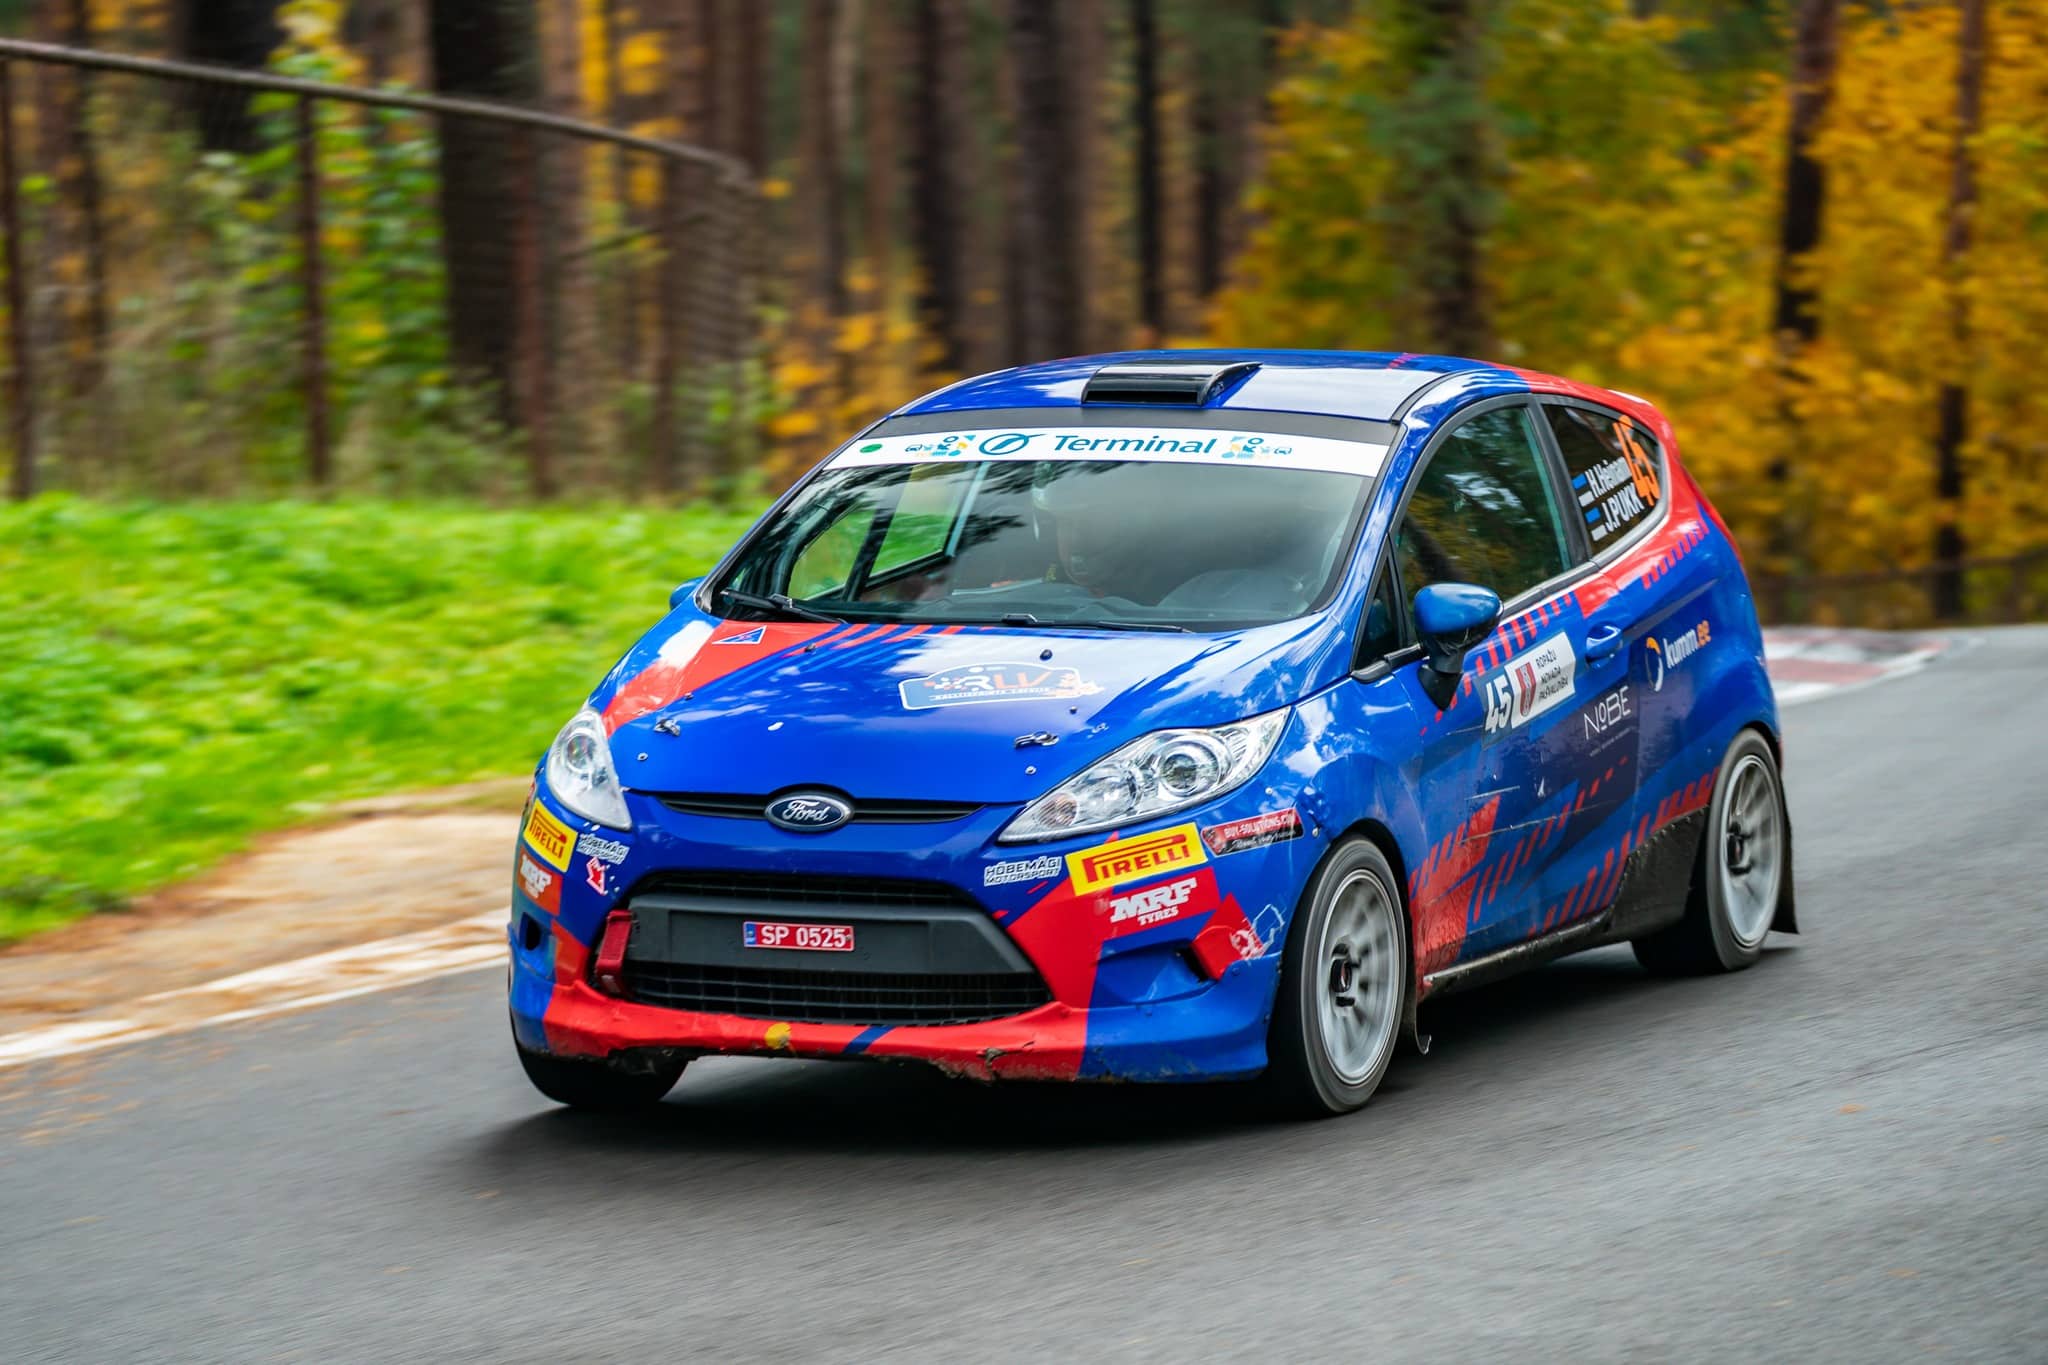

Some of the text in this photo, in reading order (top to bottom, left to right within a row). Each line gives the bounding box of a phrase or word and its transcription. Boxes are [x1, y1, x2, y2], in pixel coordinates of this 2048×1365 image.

[1053, 435, 1218, 454] Terminal
[1602, 482, 1645, 533] J.PUKK
[1663, 620, 1711, 669] kumm.ee
[1484, 675, 1512, 735] 45
[529, 808, 567, 859] PIRELLI
[782, 800, 831, 821] Ford
[1082, 833, 1191, 884] PIRELLI
[1110, 877, 1198, 923] MRF
[1137, 906, 1179, 926] TYRES
[761, 925, 848, 948] SP 0525
